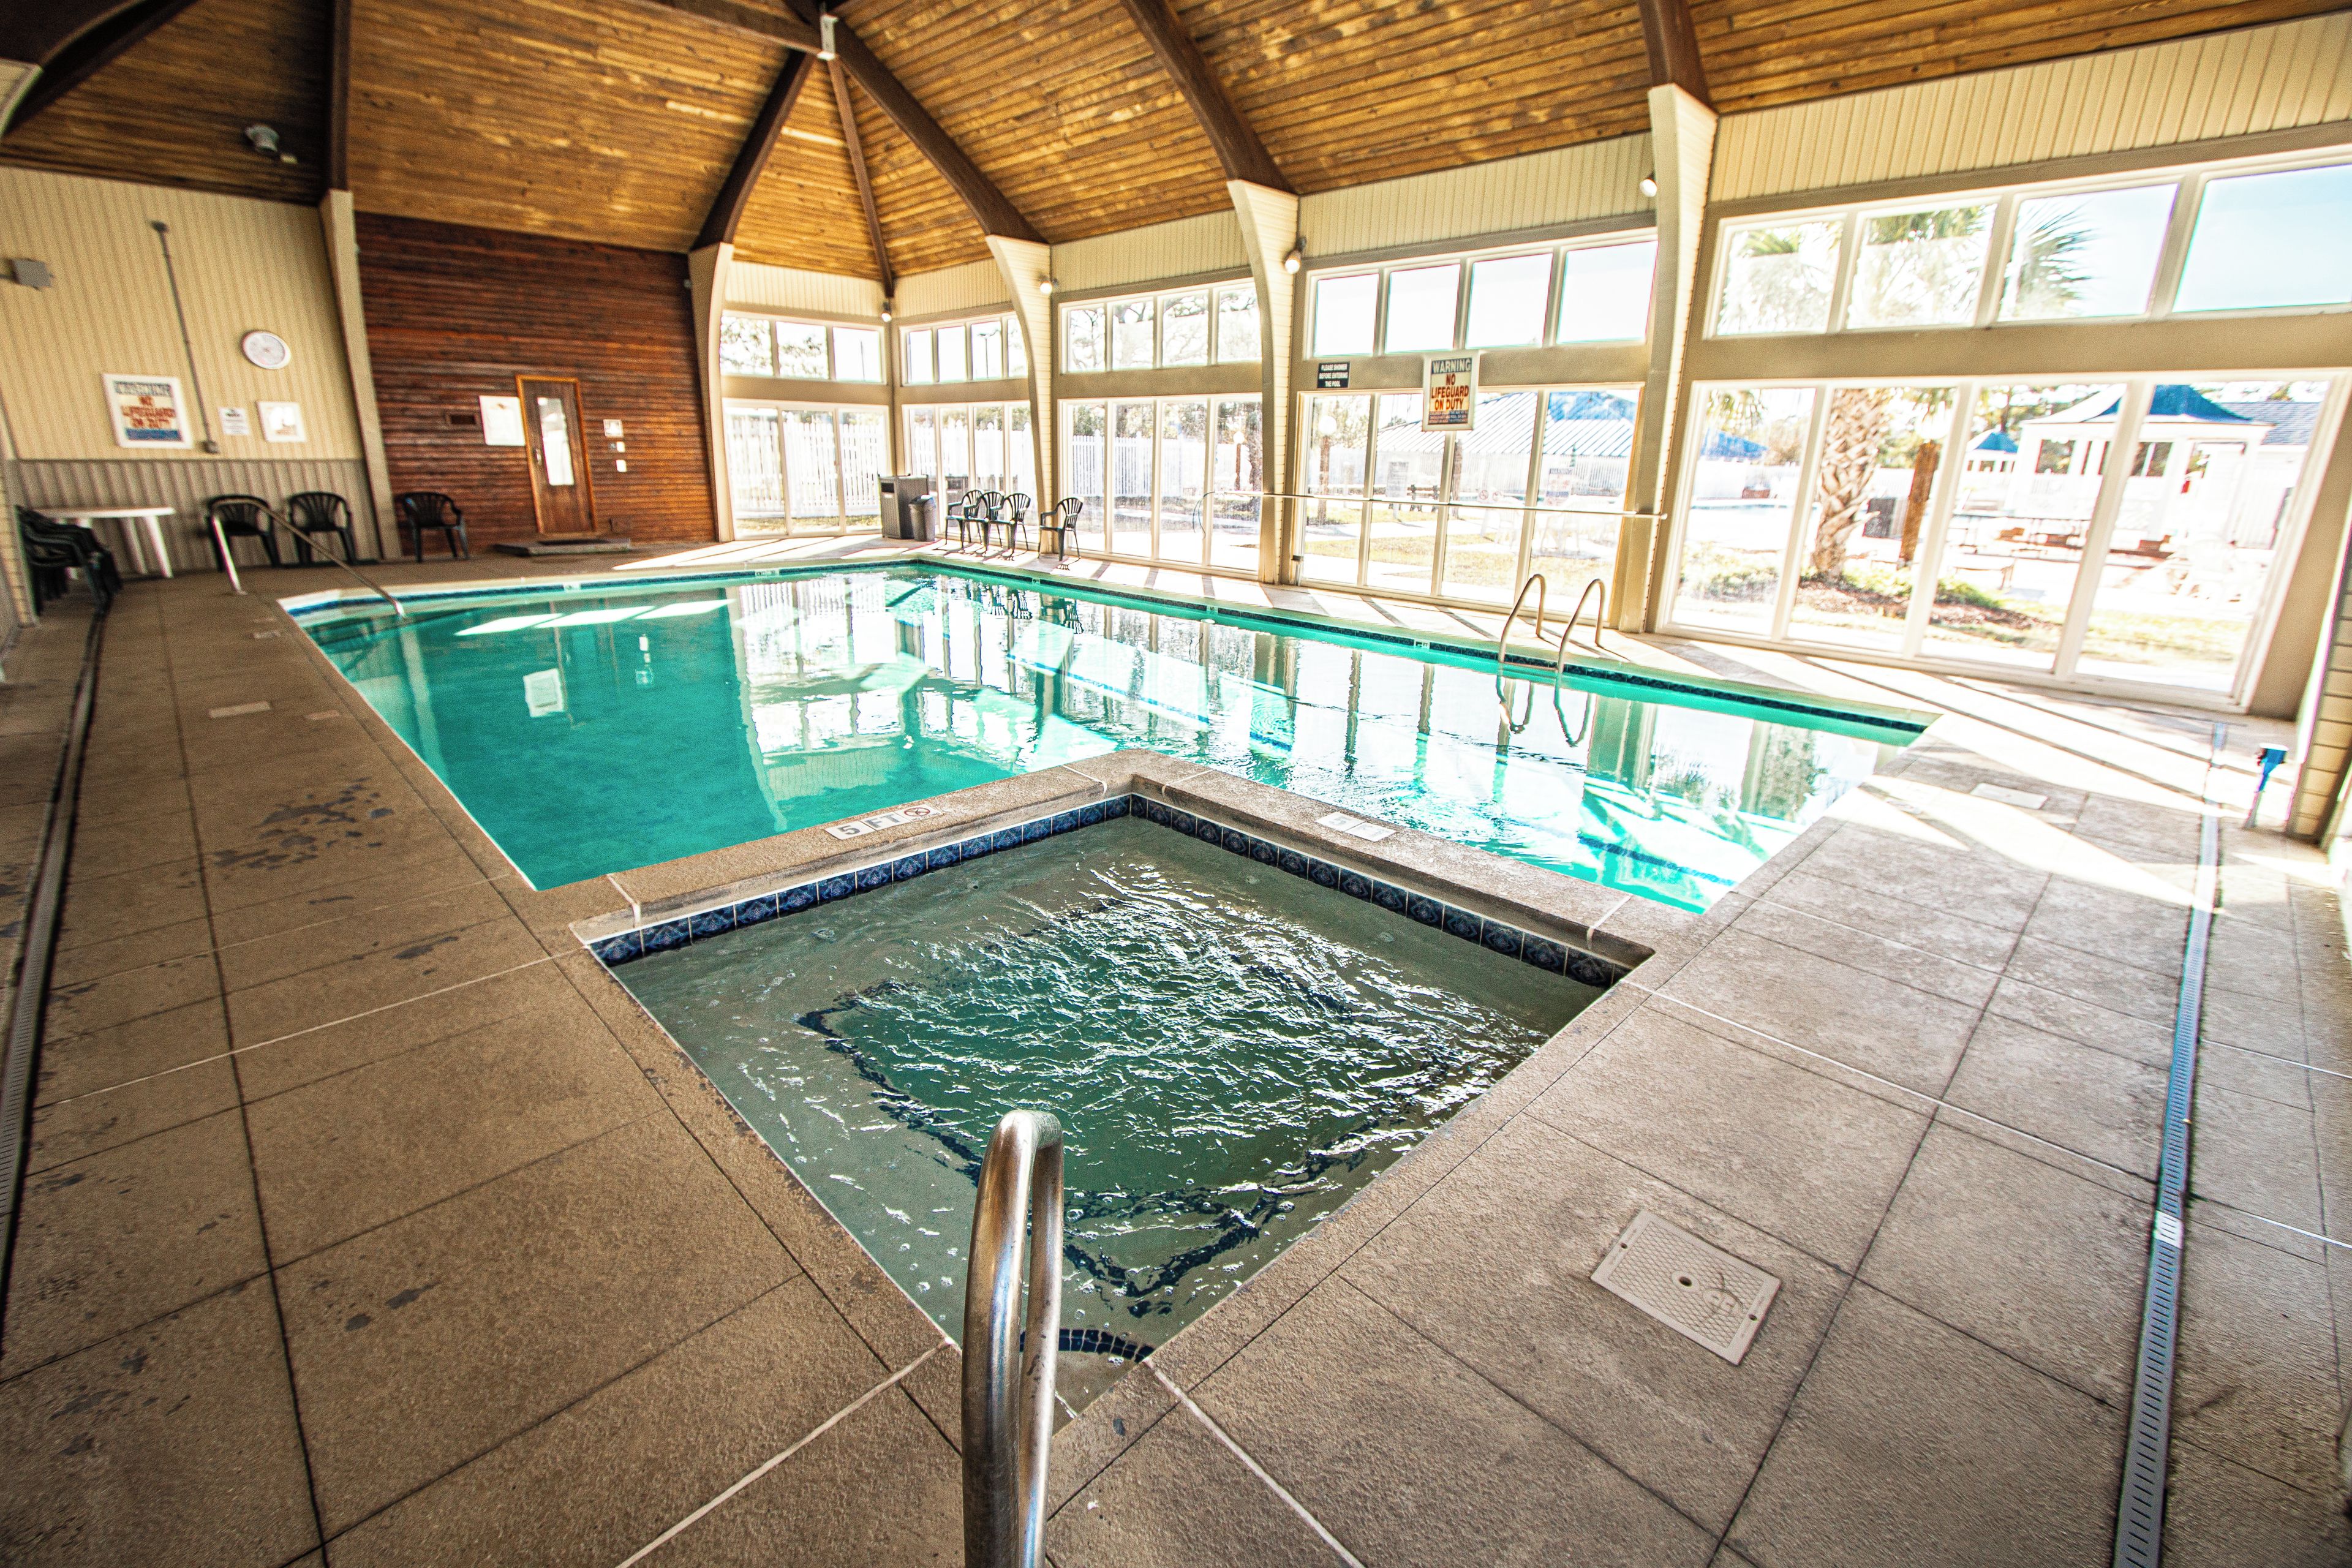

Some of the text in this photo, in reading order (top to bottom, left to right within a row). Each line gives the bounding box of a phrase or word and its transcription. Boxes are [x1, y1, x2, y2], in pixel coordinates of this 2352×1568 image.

[1433, 358, 1471, 373] WARNING
[1446, 373, 1456, 385] NO
[1431, 385, 1469, 399] LIFEGUARD
[1435, 398, 1464, 410] ON DUTY
[837, 813, 900, 835] 5 FT
